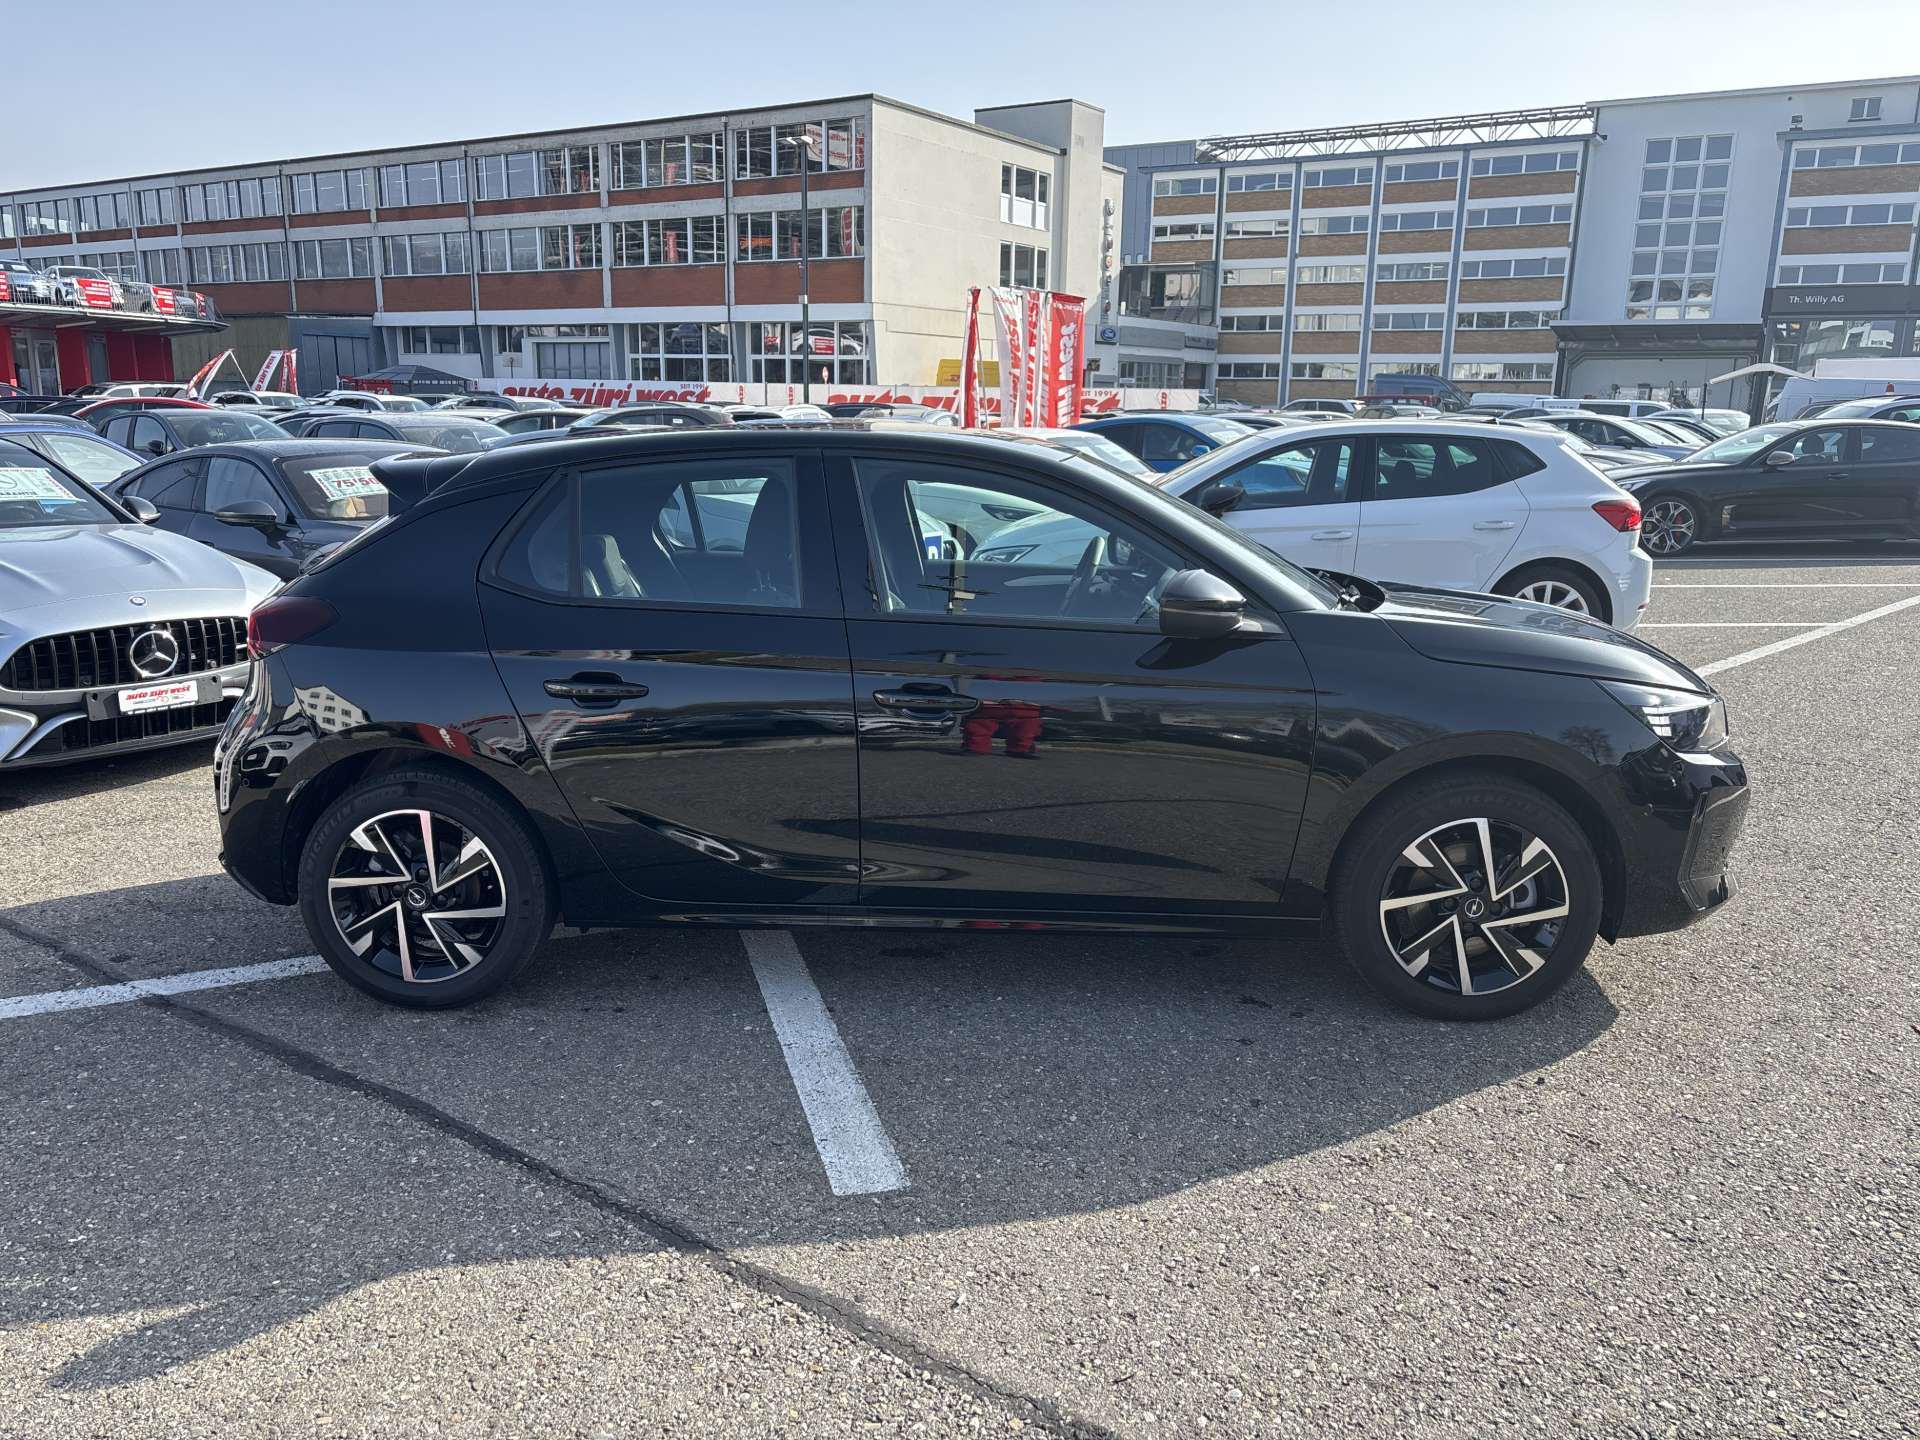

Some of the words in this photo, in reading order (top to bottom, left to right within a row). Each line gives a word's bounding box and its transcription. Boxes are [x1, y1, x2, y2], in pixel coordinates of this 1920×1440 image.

[1789, 295, 1803, 304] Th.
[1805, 295, 1829, 305] Willy
[1830, 295, 1845, 303] AG
[571, 383, 632, 407] züri
[636, 384, 712, 403] west
[127, 692, 148, 700] auto
[150, 689, 168, 697] züri
[170, 685, 191, 693] west
